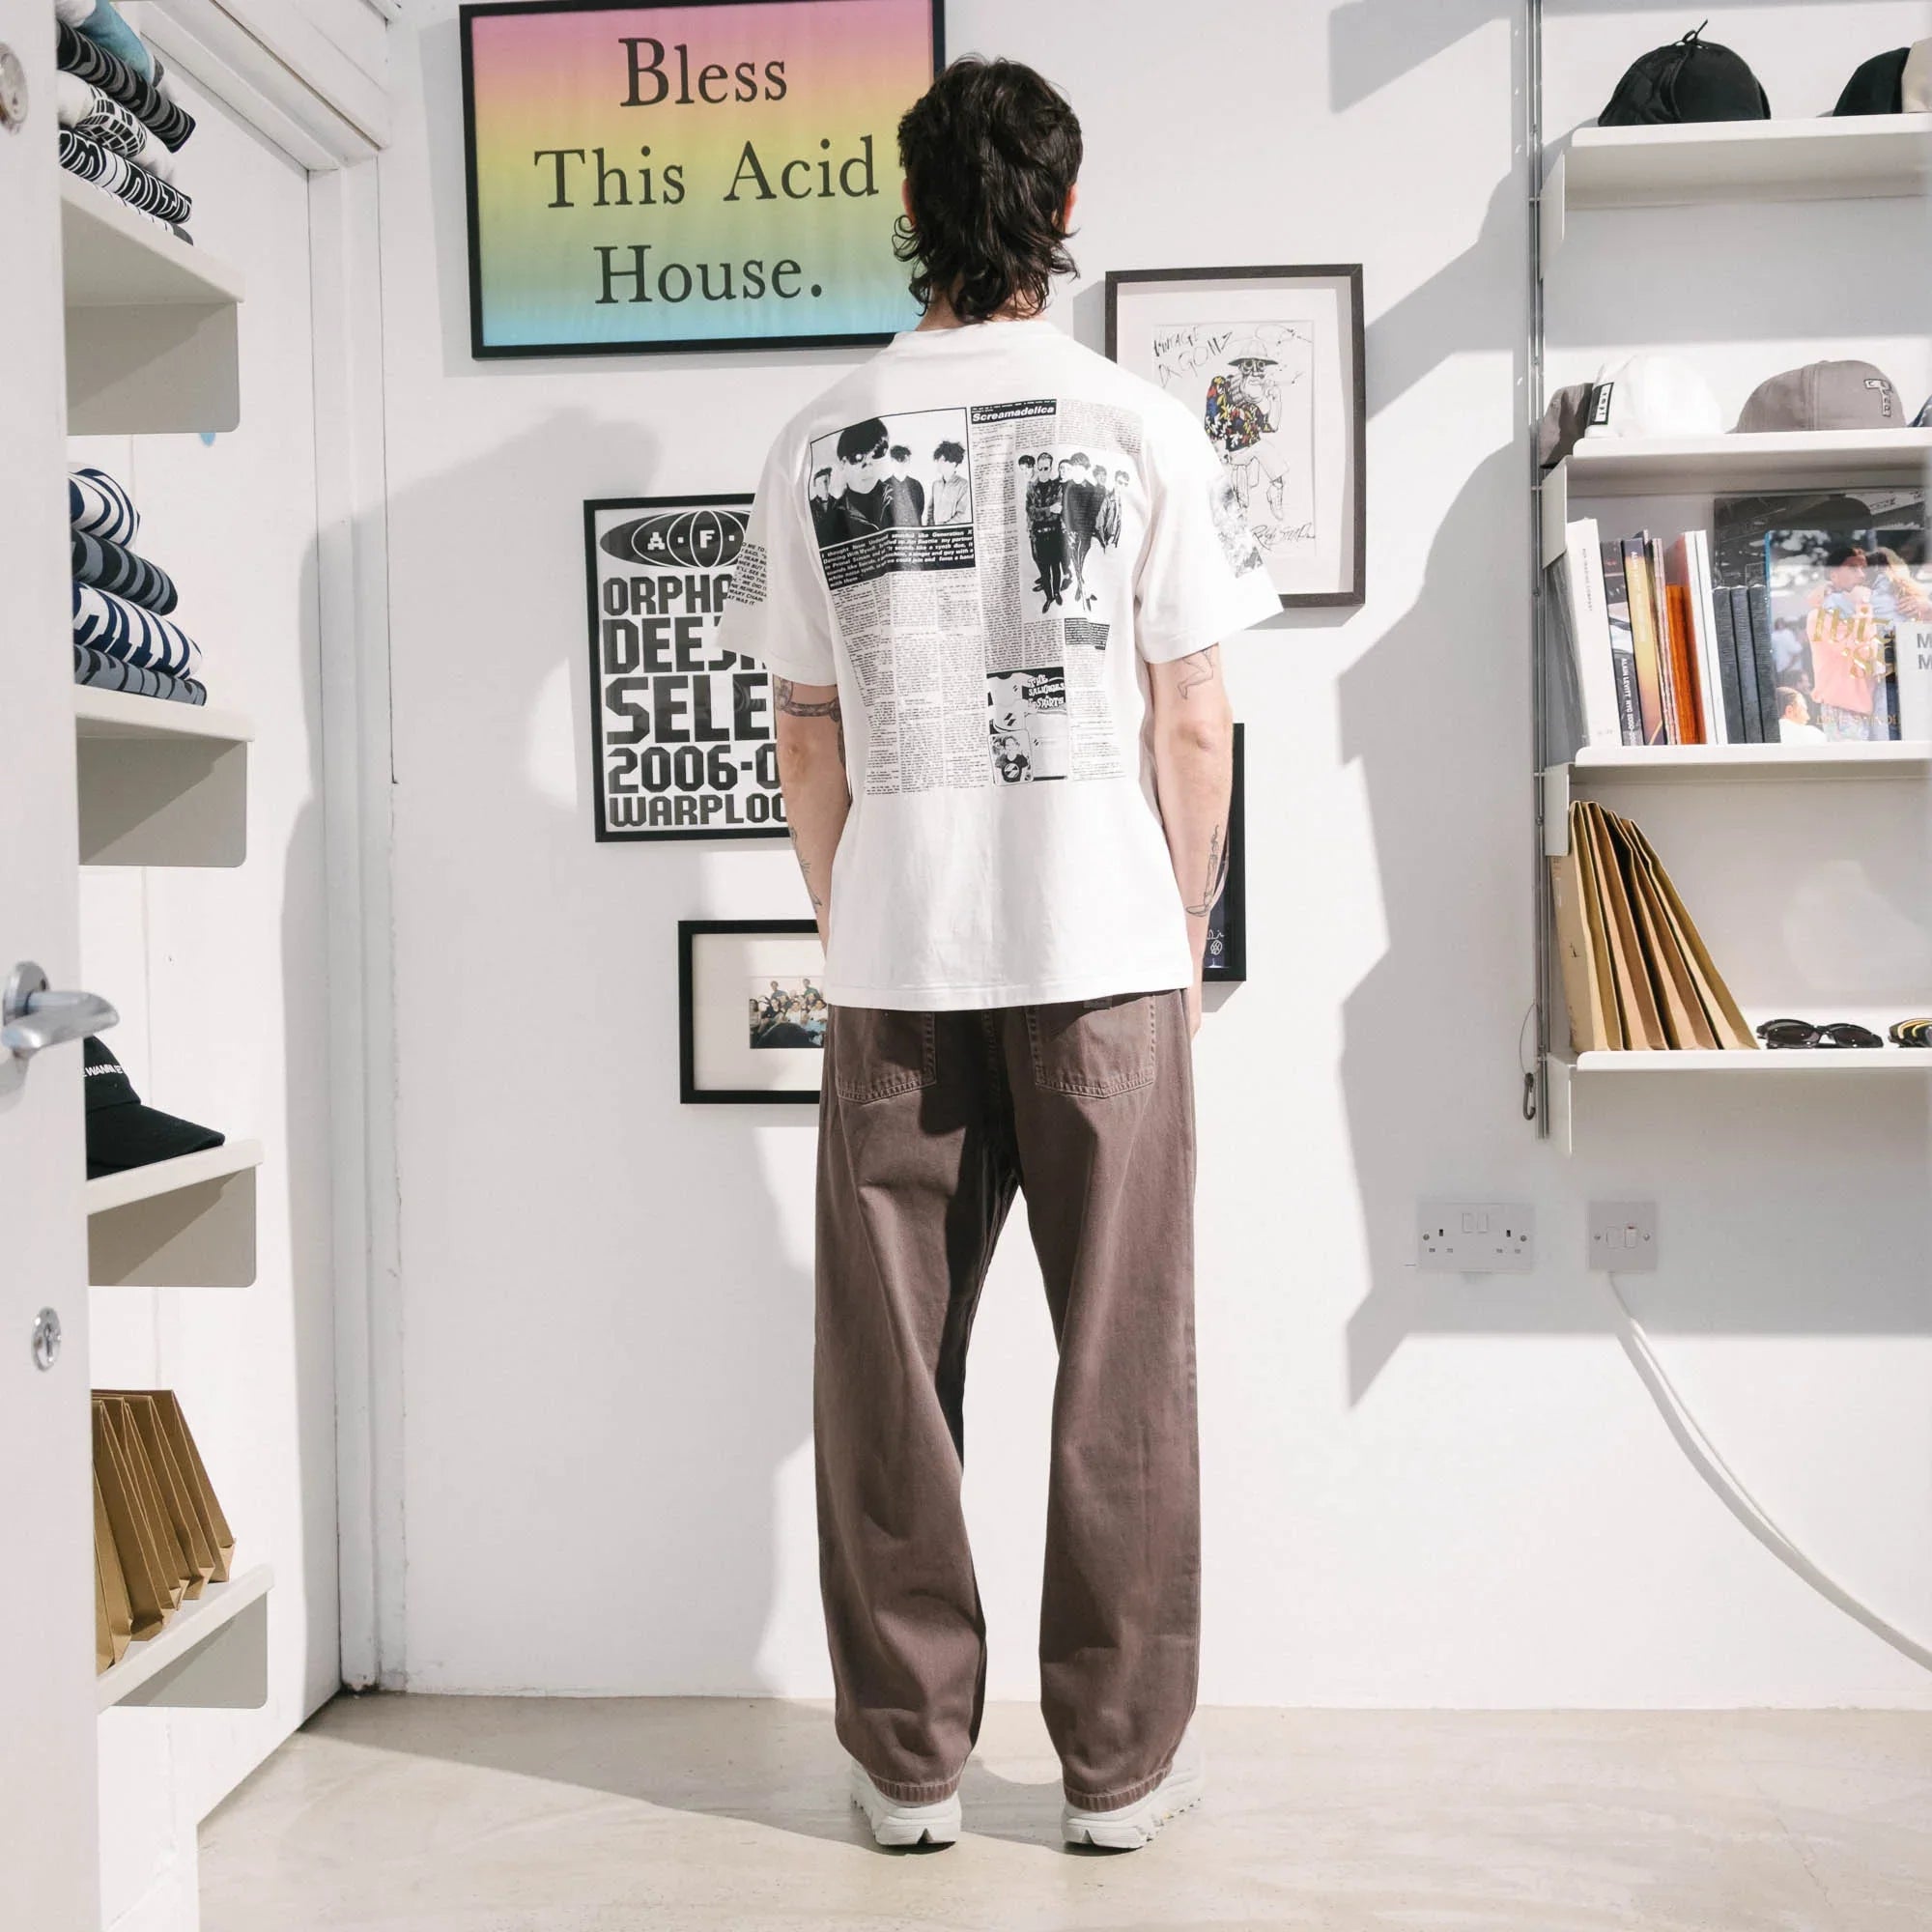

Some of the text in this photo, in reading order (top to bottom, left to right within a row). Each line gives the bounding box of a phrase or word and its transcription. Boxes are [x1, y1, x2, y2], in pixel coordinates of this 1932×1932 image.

[618, 37, 788, 107] Bless
[533, 133, 879, 209] This Acid
[593, 244, 823, 304] House.
[972, 406, 1055, 421] Screamadelica
[603, 574, 733, 616] ORPHA
[740, 585, 767, 598] REHEARSA
[605, 672, 778, 745] SELE
[1623, 676, 1632, 697] LEVITT
[607, 743, 780, 794] 2006-0
